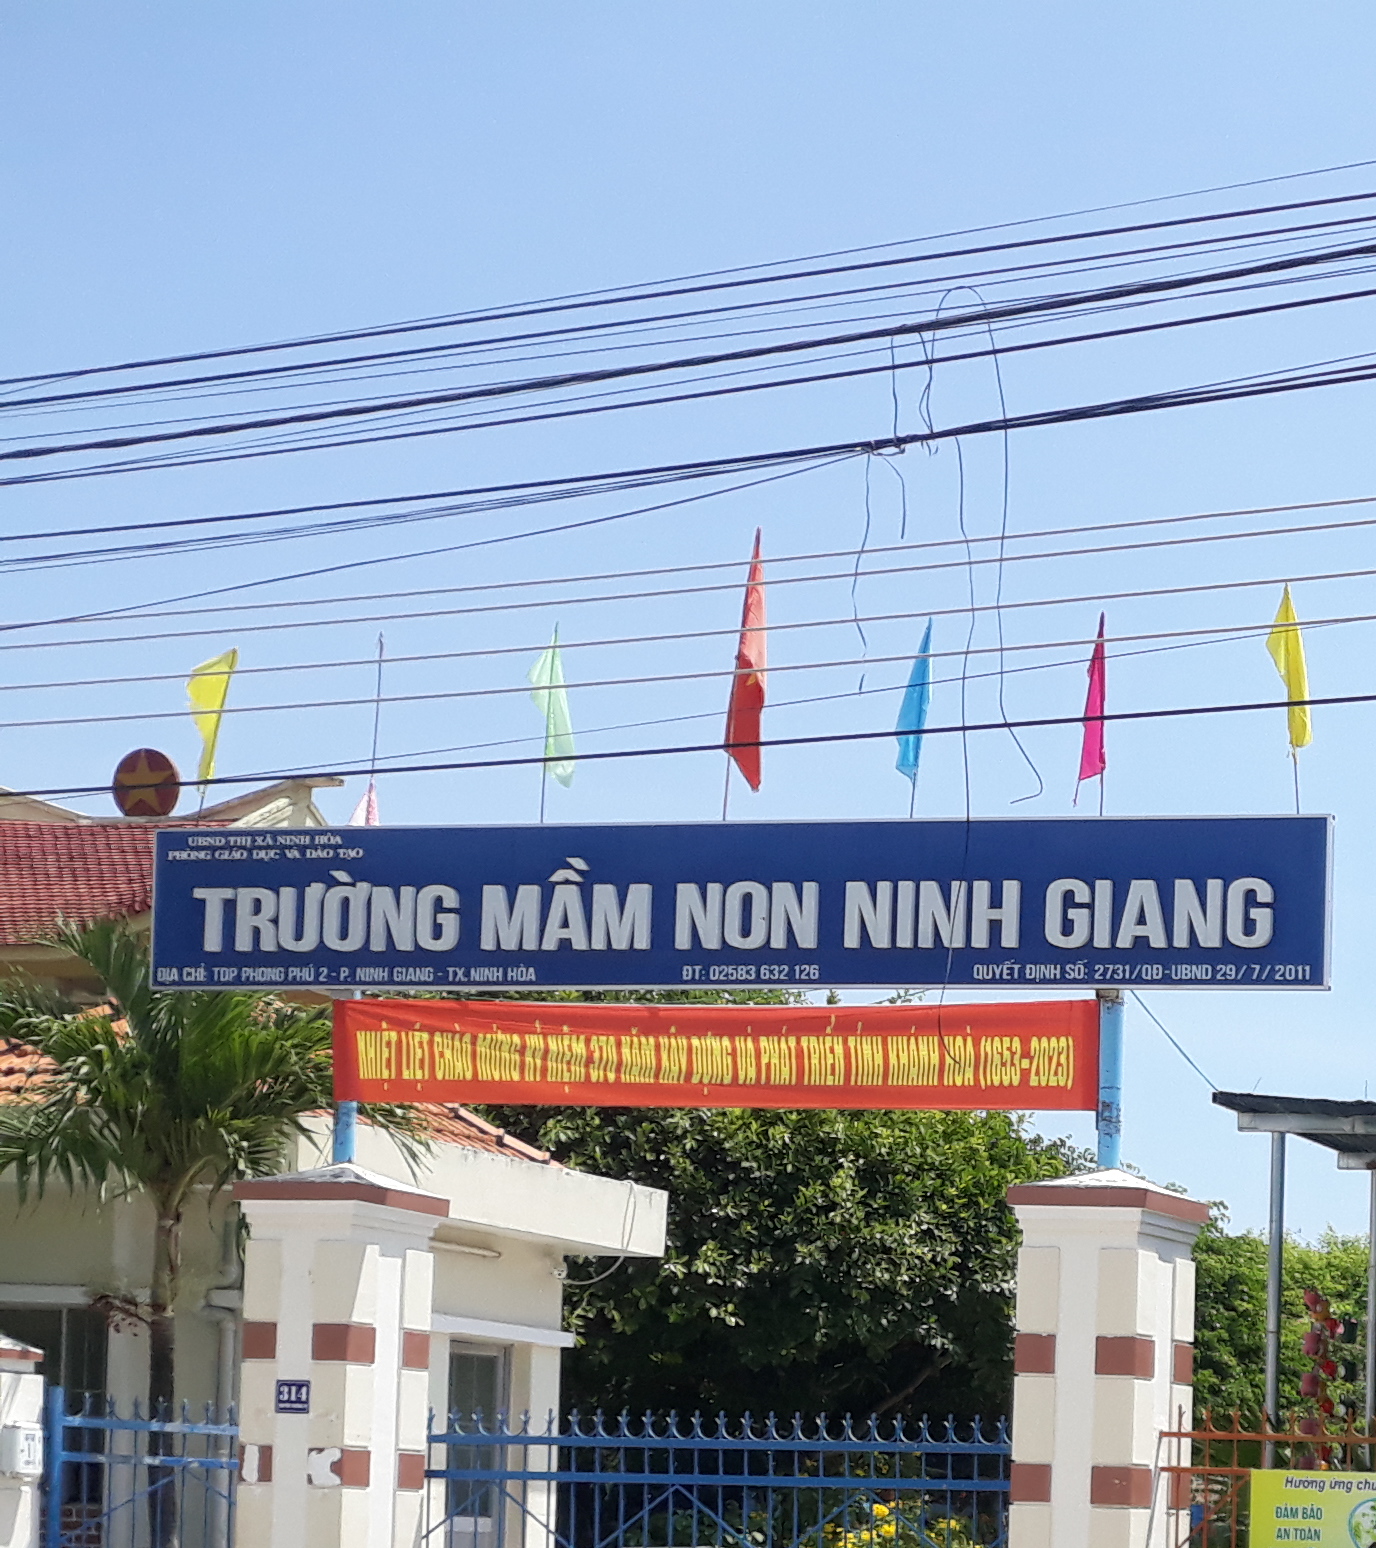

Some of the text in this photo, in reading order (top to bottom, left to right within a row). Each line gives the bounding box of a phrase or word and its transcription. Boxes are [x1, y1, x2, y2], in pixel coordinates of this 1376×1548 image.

[187, 832, 343, 848] UBND THỊ XÃ NINH HÒA
[167, 848, 211, 860] PHÒNG
[215, 847, 248, 860] GIÁO
[252, 848, 280, 862] DỤC
[285, 846, 301, 859] VÀ
[193, 857, 1275, 953] TRƯỜNG MẦM NON NINH GIANG
[212, 967, 237, 982] TDP
[241, 967, 285, 982] PHONG
[288, 963, 314, 982] PHÚ
[319, 967, 328, 982] 2
[355, 967, 388, 982] NINH
[393, 967, 434, 982] GIANG
[507, 963, 537, 982] HÒA
[709, 965, 756, 980] 02583
[760, 964, 789, 980] 632
[794, 964, 820, 980] 126
[973, 959, 1021, 980] QUYẾT
[1025, 964, 1061, 982] ĐỊNH
[1065, 959, 1088, 980] SỐ:
[1094, 964, 1212, 980] 2731/QĐ-UBND
[356, 1020, 398, 1091] NHIỆT
[401, 1021, 430, 1091] LIỆT
[434, 1022, 473, 1081] CHÀO
[476, 1023, 521, 1081] MỪNG
[547, 1024, 586, 1093] NIỆM
[590, 1035, 617, 1083] 370
[621, 1026, 656, 1083] NĂM
[659, 1025, 688, 1084] XÂY
[690, 1030, 732, 1095] DỰNG
[735, 1025, 756, 1084] VÀ
[759, 1025, 797, 1085] PHÁT
[800, 1014, 844, 1086] TRIỂN
[848, 1021, 883, 1086] TỈNH
[887, 1025, 939, 1086] KHÁNH
[979, 1035, 1074, 1091] (1653-2023)
[279, 1385, 307, 1401] 314
[1329, 1477, 1354, 1494] ứng
[1302, 1503, 1323, 1520] BẢO
[1276, 1526, 1321, 1542] AN TOÀN
